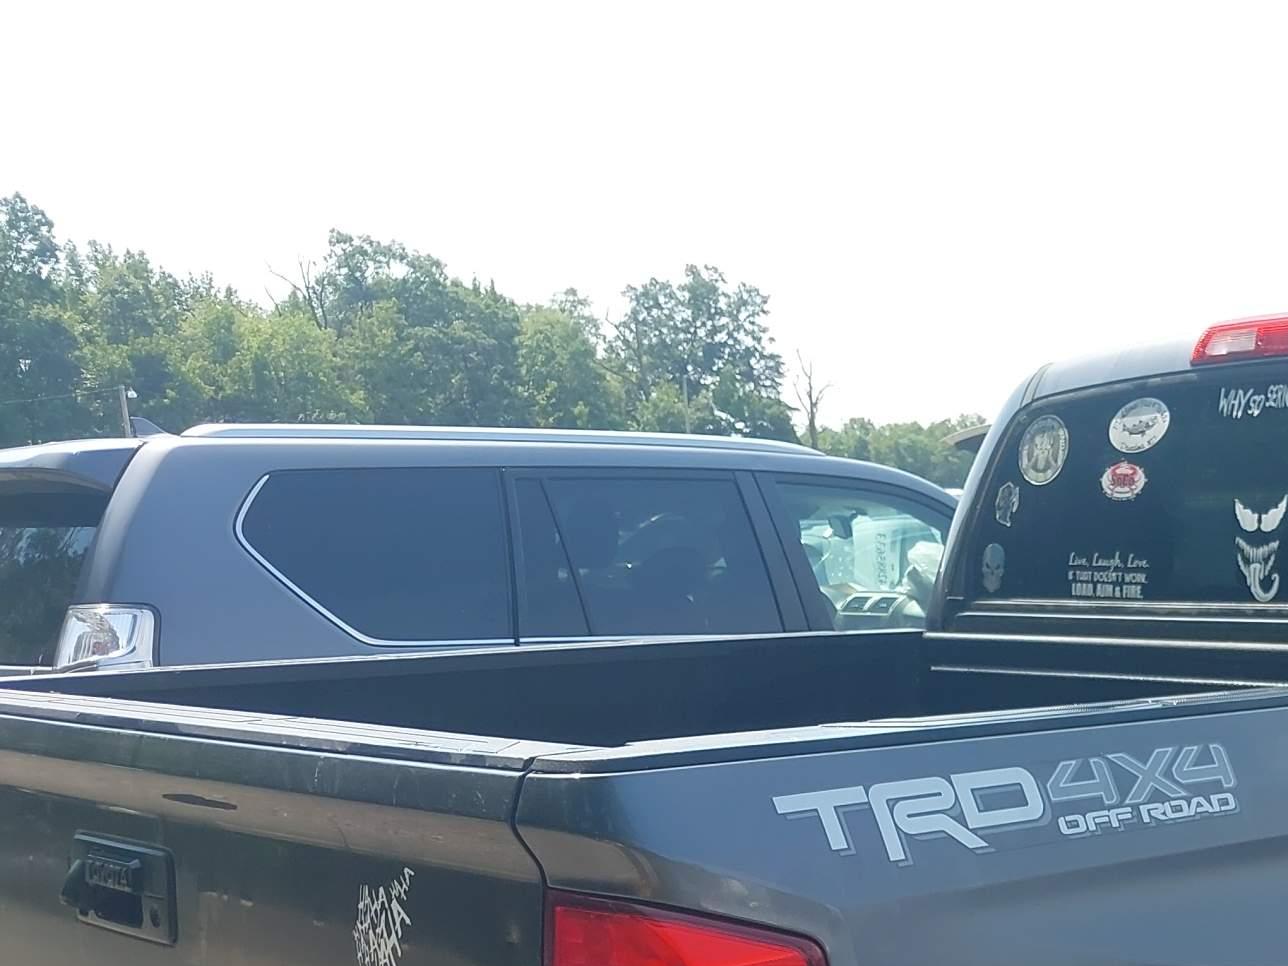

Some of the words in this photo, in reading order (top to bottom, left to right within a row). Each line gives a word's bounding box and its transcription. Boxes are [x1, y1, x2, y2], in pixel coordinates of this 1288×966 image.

[1218, 387, 1254, 419] WHY
[771, 766, 1046, 863] TRD
[1057, 806, 1133, 836] OFF
[1140, 792, 1236, 826] ROAD
